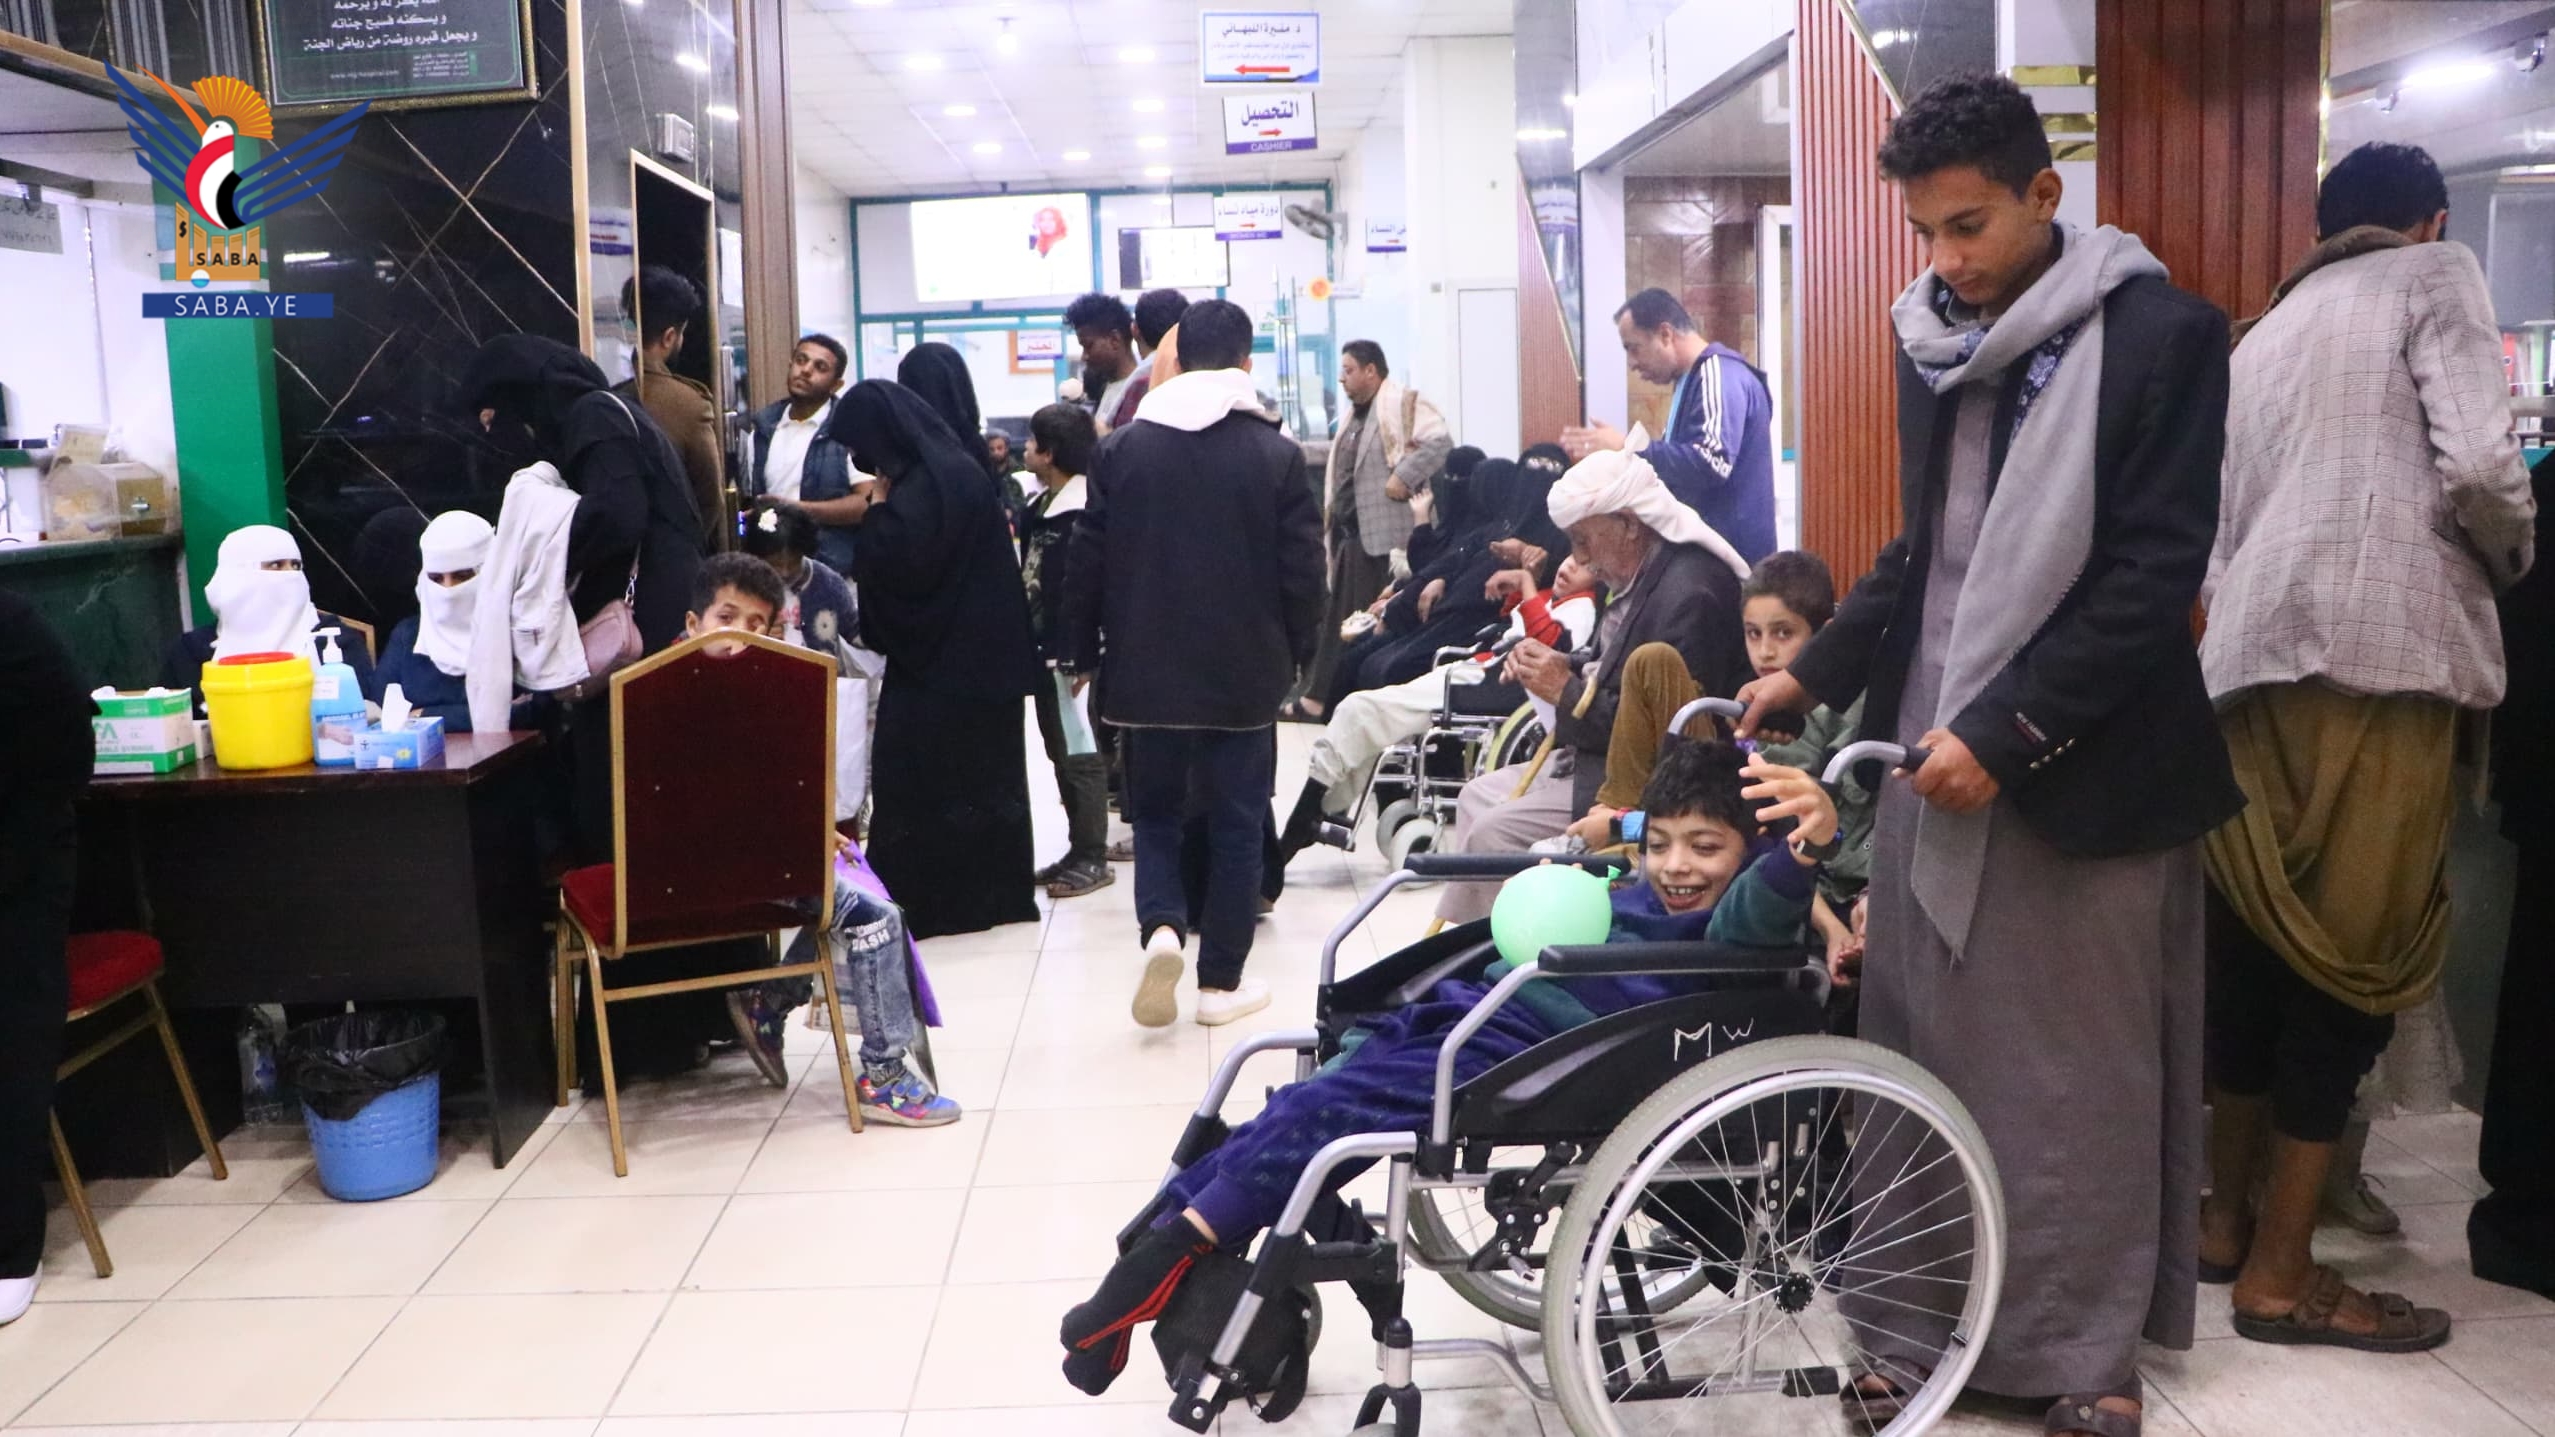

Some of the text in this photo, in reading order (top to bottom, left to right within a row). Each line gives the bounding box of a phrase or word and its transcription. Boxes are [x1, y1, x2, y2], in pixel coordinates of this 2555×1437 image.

[331, 19, 363, 30] جناته
[365, 15, 394, 30] فسيح
[367, 35, 381, 48] من
[1241, 99, 1300, 127] التحصيل
[1250, 140, 1293, 152] CASHIER
